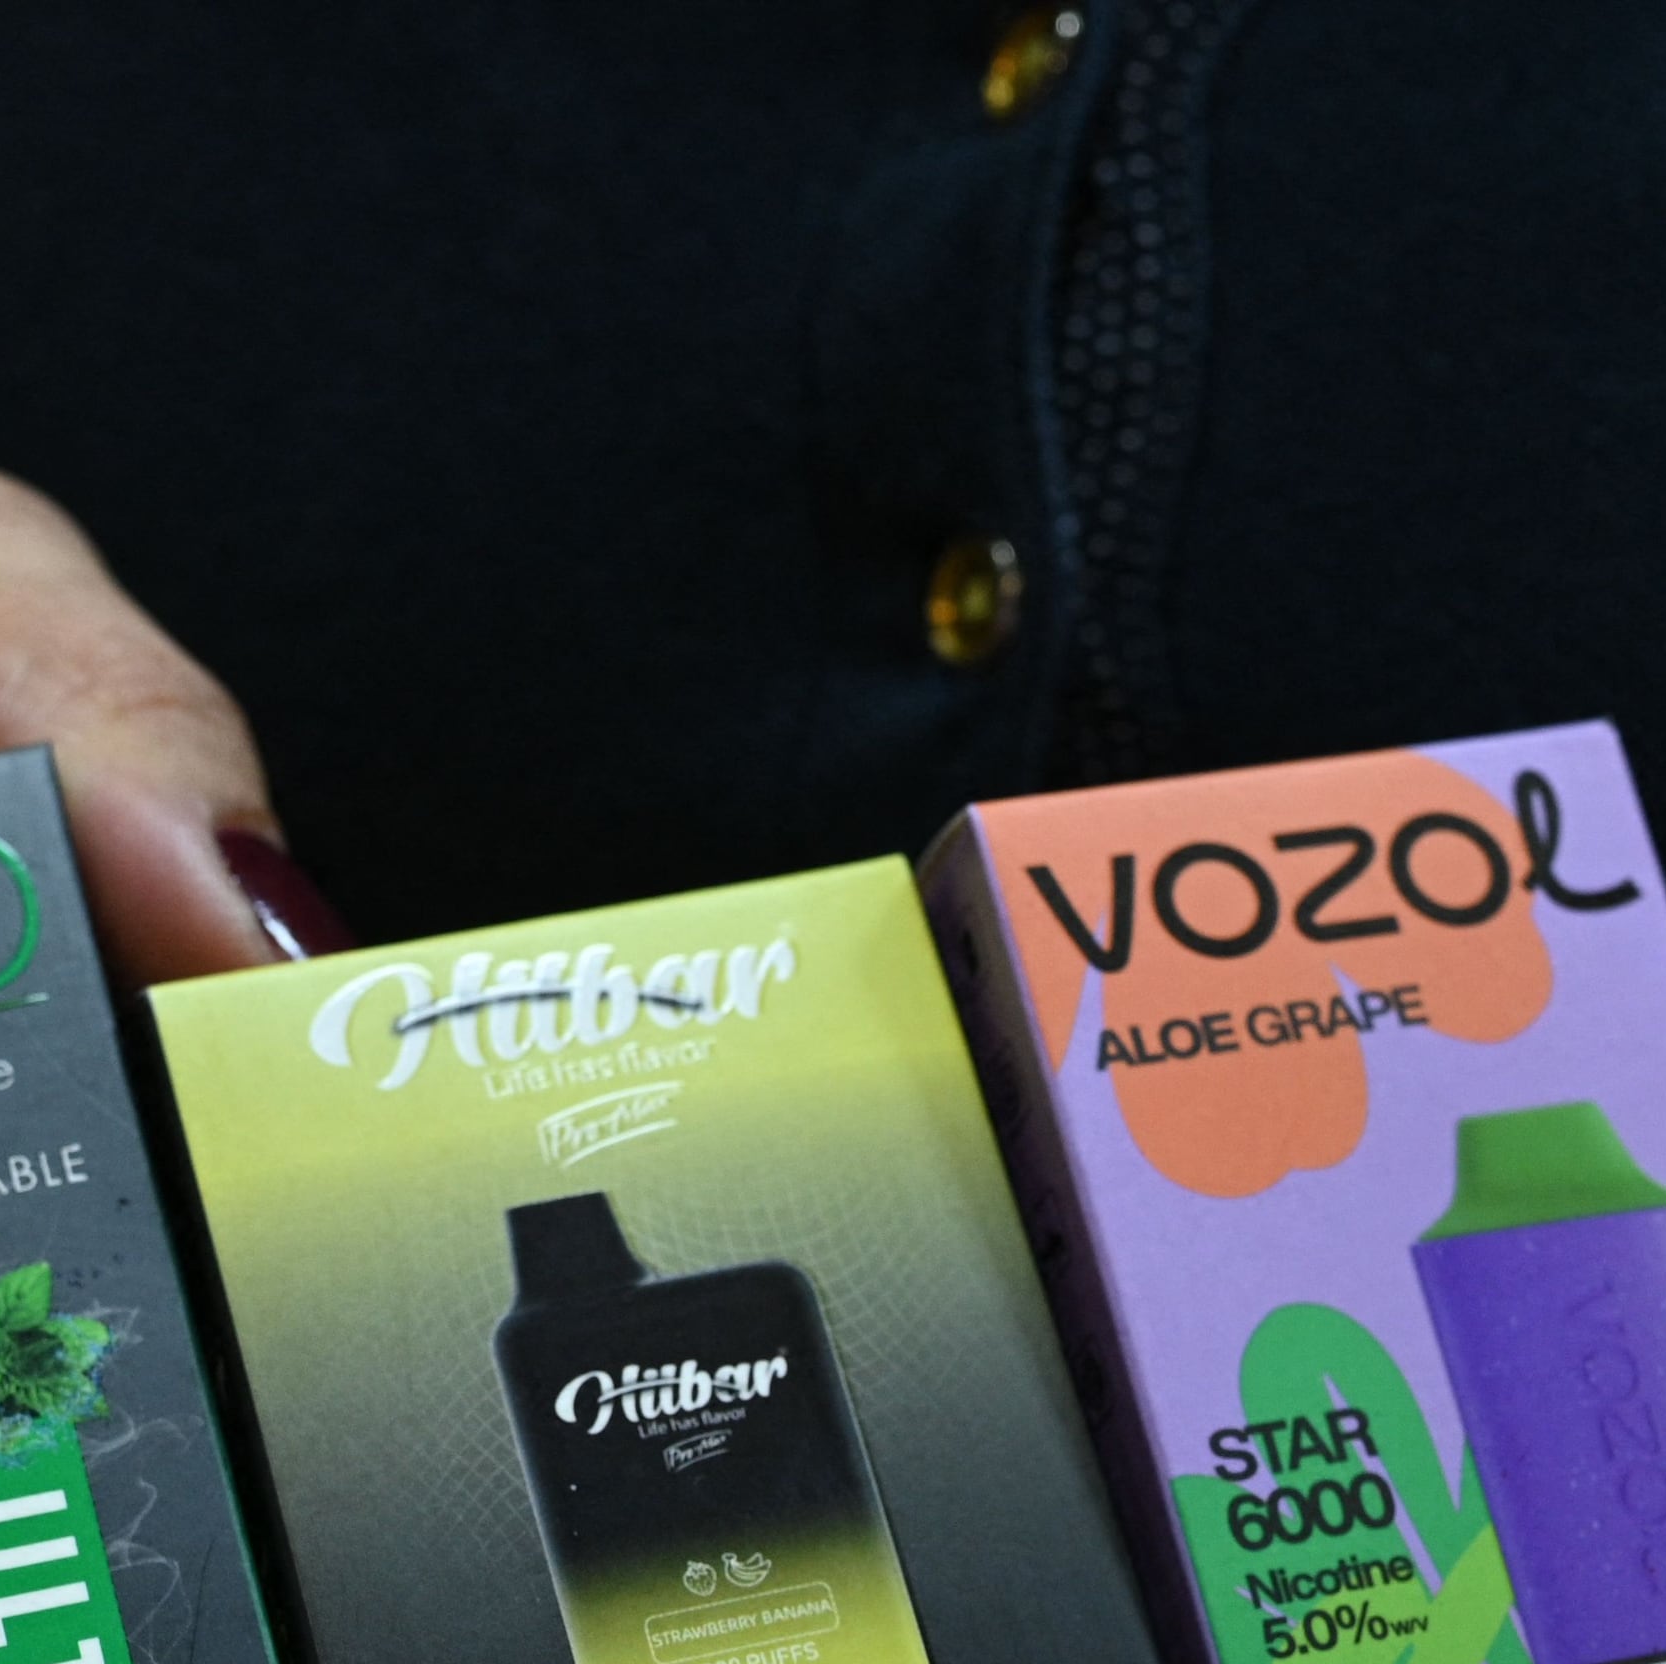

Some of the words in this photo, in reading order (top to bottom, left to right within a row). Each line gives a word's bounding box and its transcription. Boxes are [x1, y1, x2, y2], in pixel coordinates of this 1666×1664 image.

[1095, 1012, 1239, 1071] ALOE
[1244, 985, 1429, 1048] GRAPE
[637, 1421, 667, 1440] Life
[669, 1416, 700, 1432] has
[701, 1407, 747, 1426] flavor
[1208, 1408, 1378, 1483] STAR
[1227, 1472, 1395, 1552] 6000
[1245, 1550, 1414, 1609] Nicotine
[651, 1614, 757, 1649] STRAWBERRY
[761, 1598, 831, 1627] BANANA
